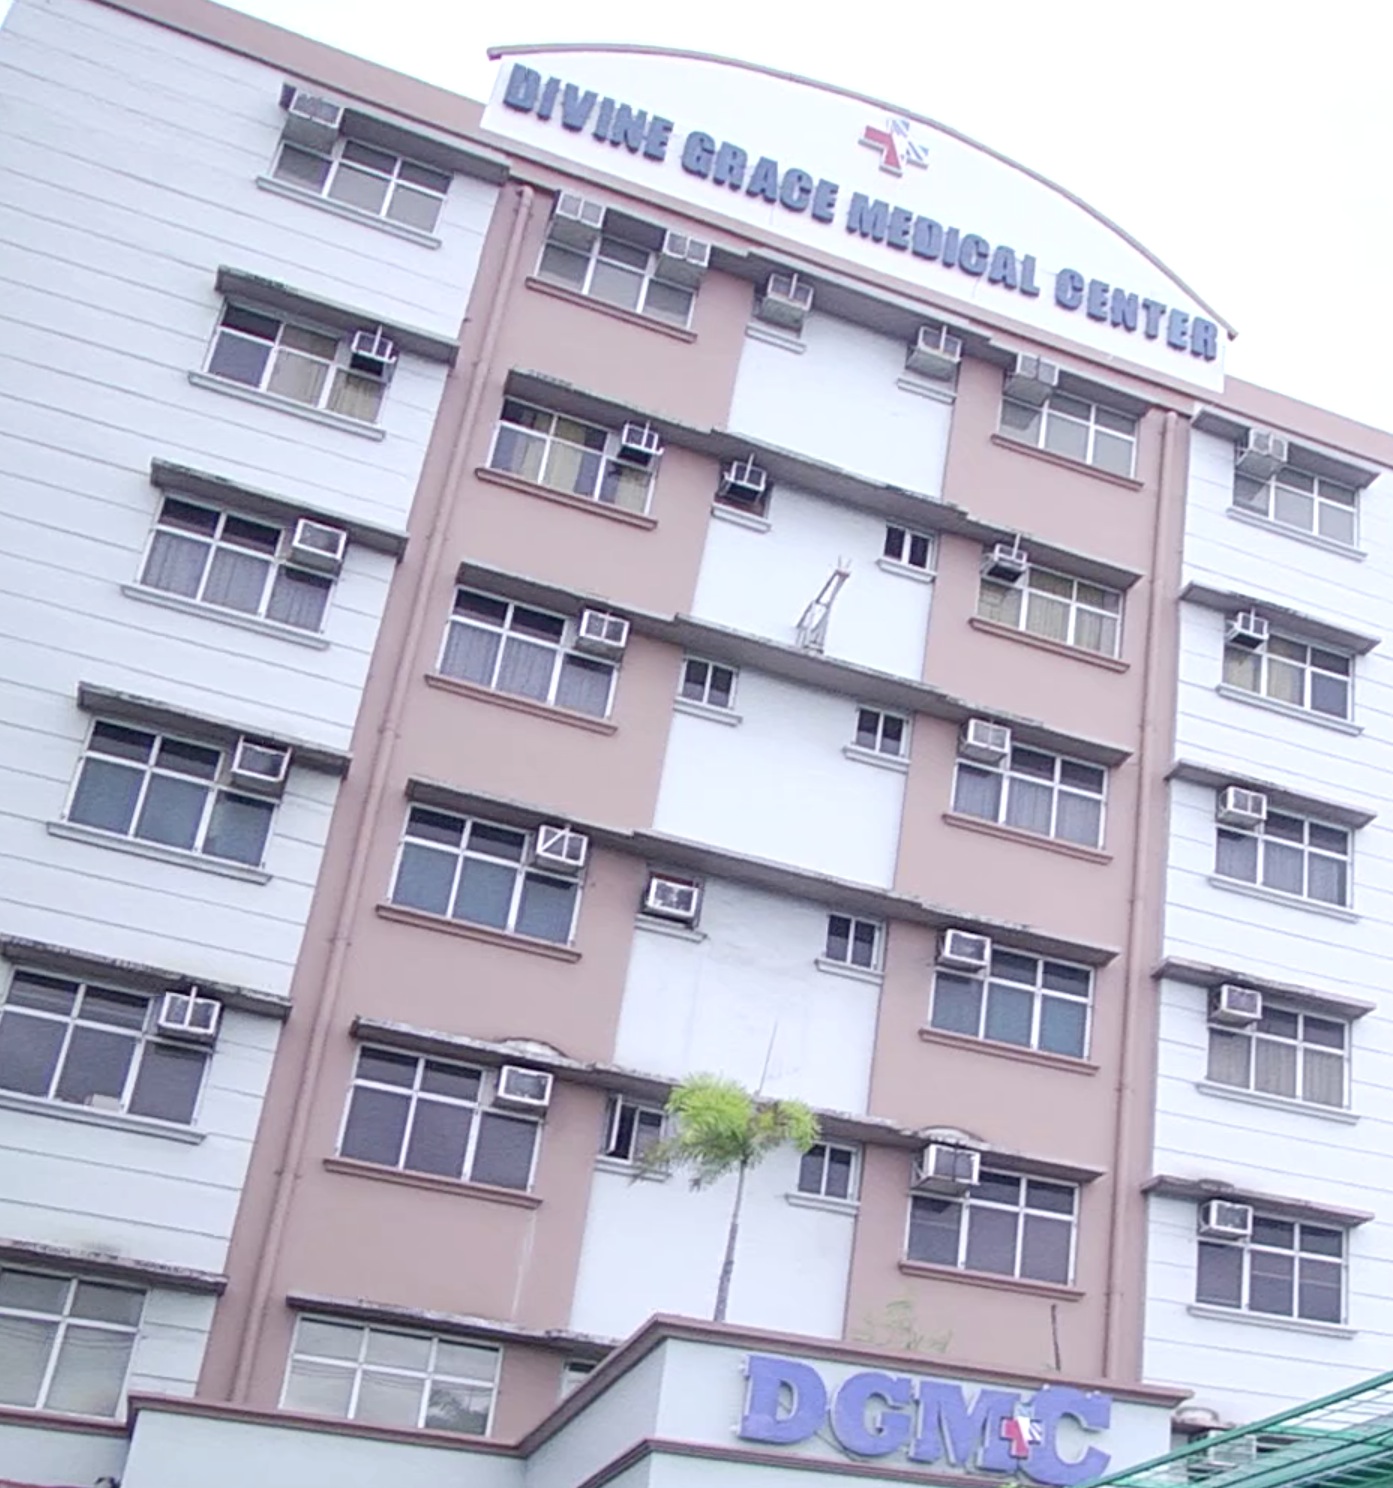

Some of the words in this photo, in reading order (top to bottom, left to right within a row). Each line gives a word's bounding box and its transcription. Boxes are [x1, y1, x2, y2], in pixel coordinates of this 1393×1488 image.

[503, 63, 674, 162] DIVINE
[681, 131, 840, 224] GRACE
[846, 191, 1040, 298] MEDICAL
[1055, 268, 1219, 361] CENTER
[737, 1355, 1112, 1487] DGMC
